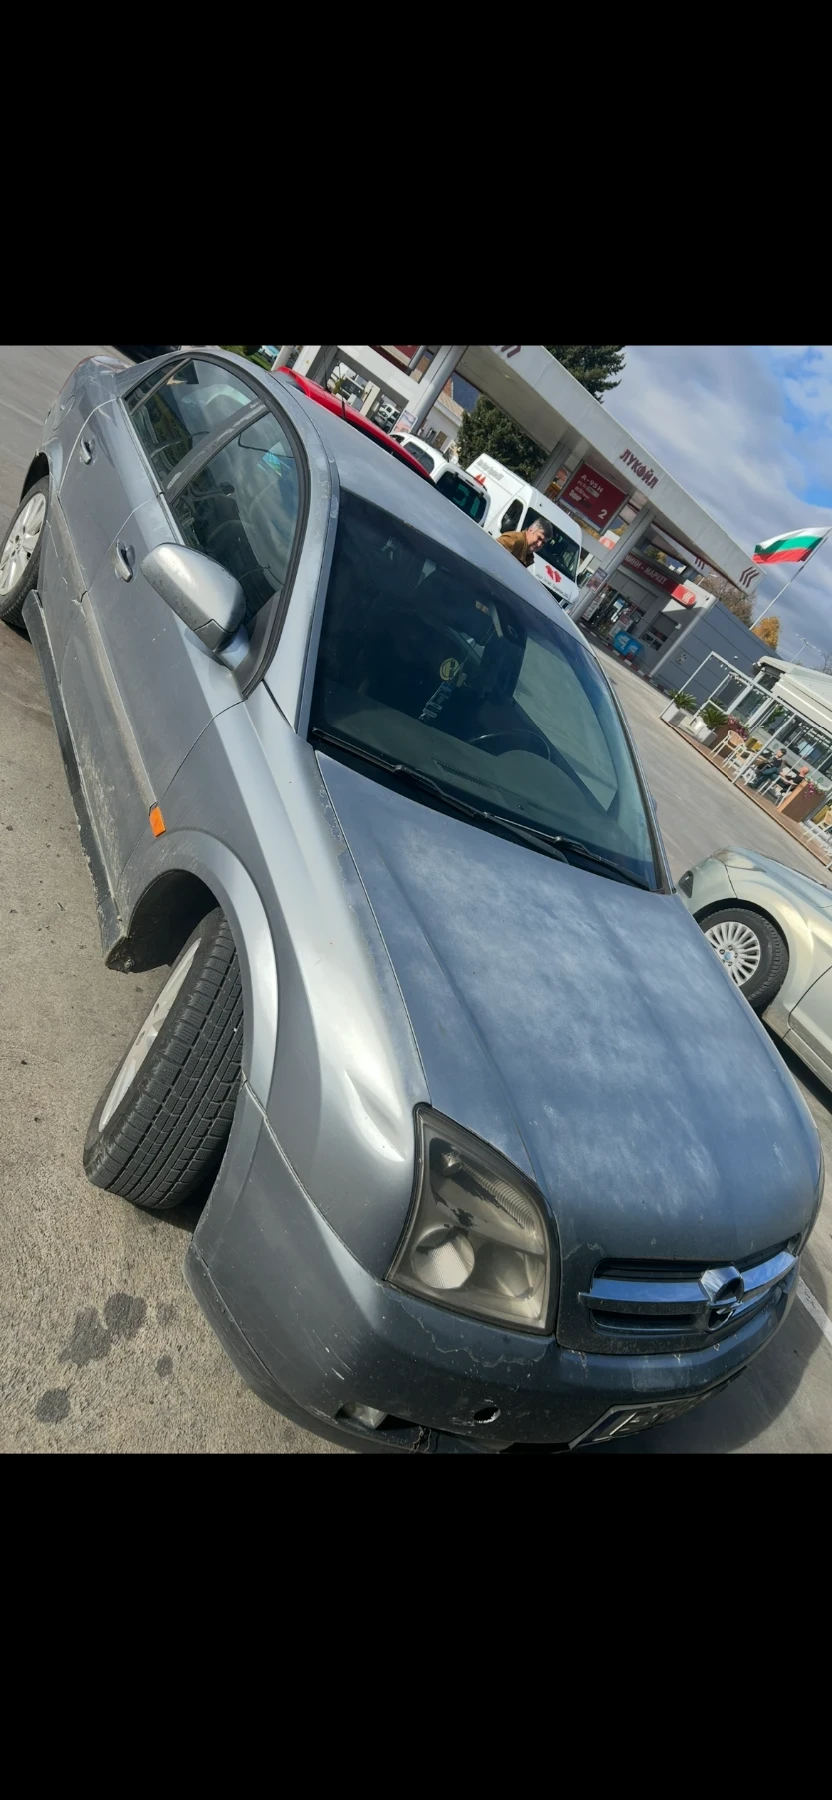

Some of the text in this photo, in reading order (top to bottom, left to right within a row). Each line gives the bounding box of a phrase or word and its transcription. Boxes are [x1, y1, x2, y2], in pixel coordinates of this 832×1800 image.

[619, 448, 659, 489] ЛУКОЙЛ
[597, 508, 608, 519] 2
[643, 565, 668, 585] МАРКЕТ
